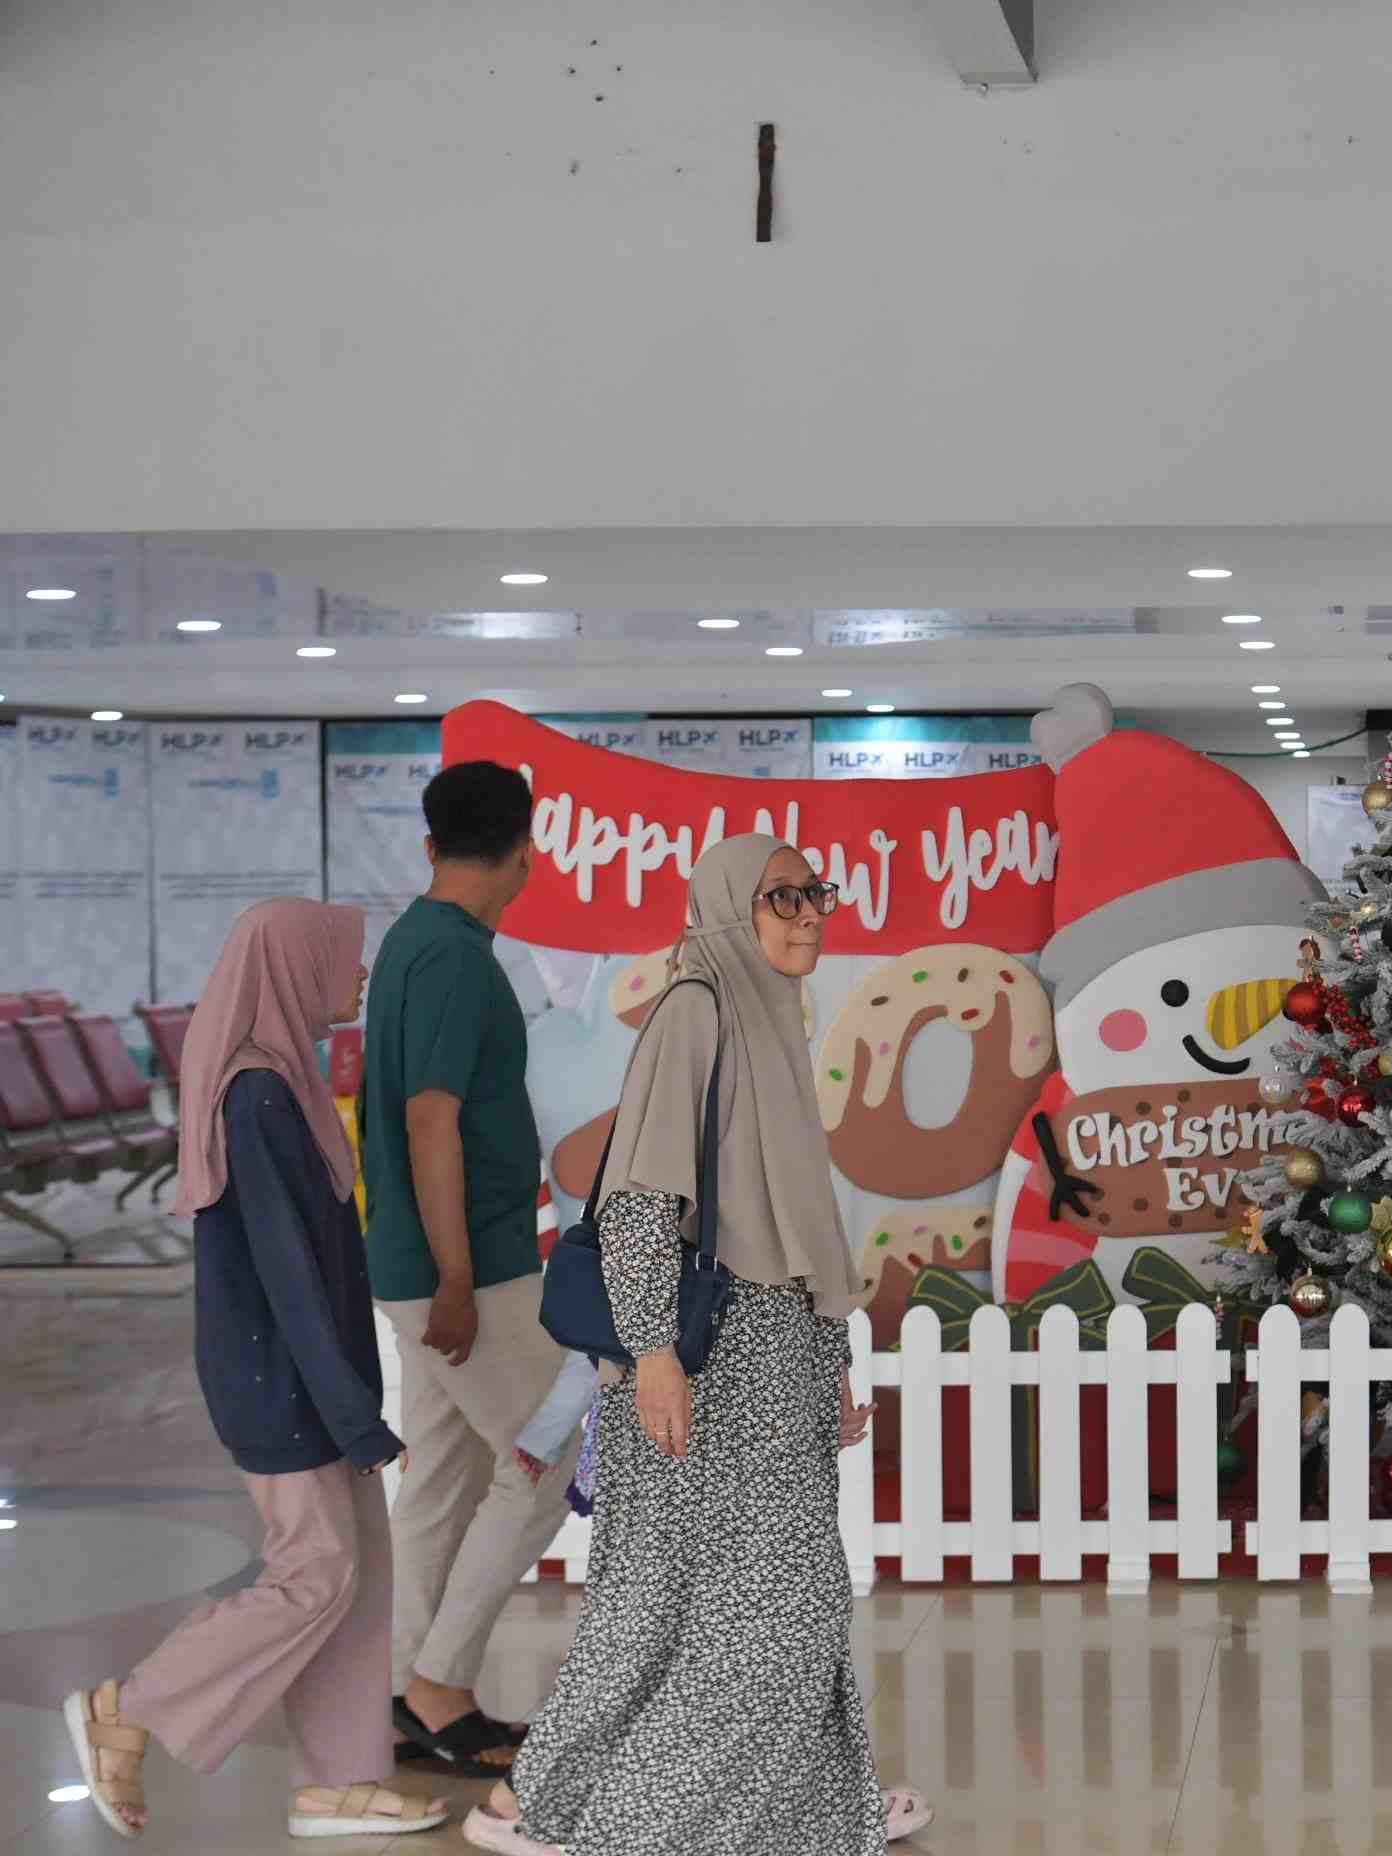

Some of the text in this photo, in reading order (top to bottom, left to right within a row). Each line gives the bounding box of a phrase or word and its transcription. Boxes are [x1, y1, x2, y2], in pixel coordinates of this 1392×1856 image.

[658, 730, 700, 746] HLP
[739, 730, 781, 746] HLP
[829, 752, 868, 768] HLP
[905, 752, 944, 768] HLP
[989, 753, 1028, 769] HLP
[1067, 1104, 1286, 1171] Christm
[1164, 1167, 1258, 1212] Ev
